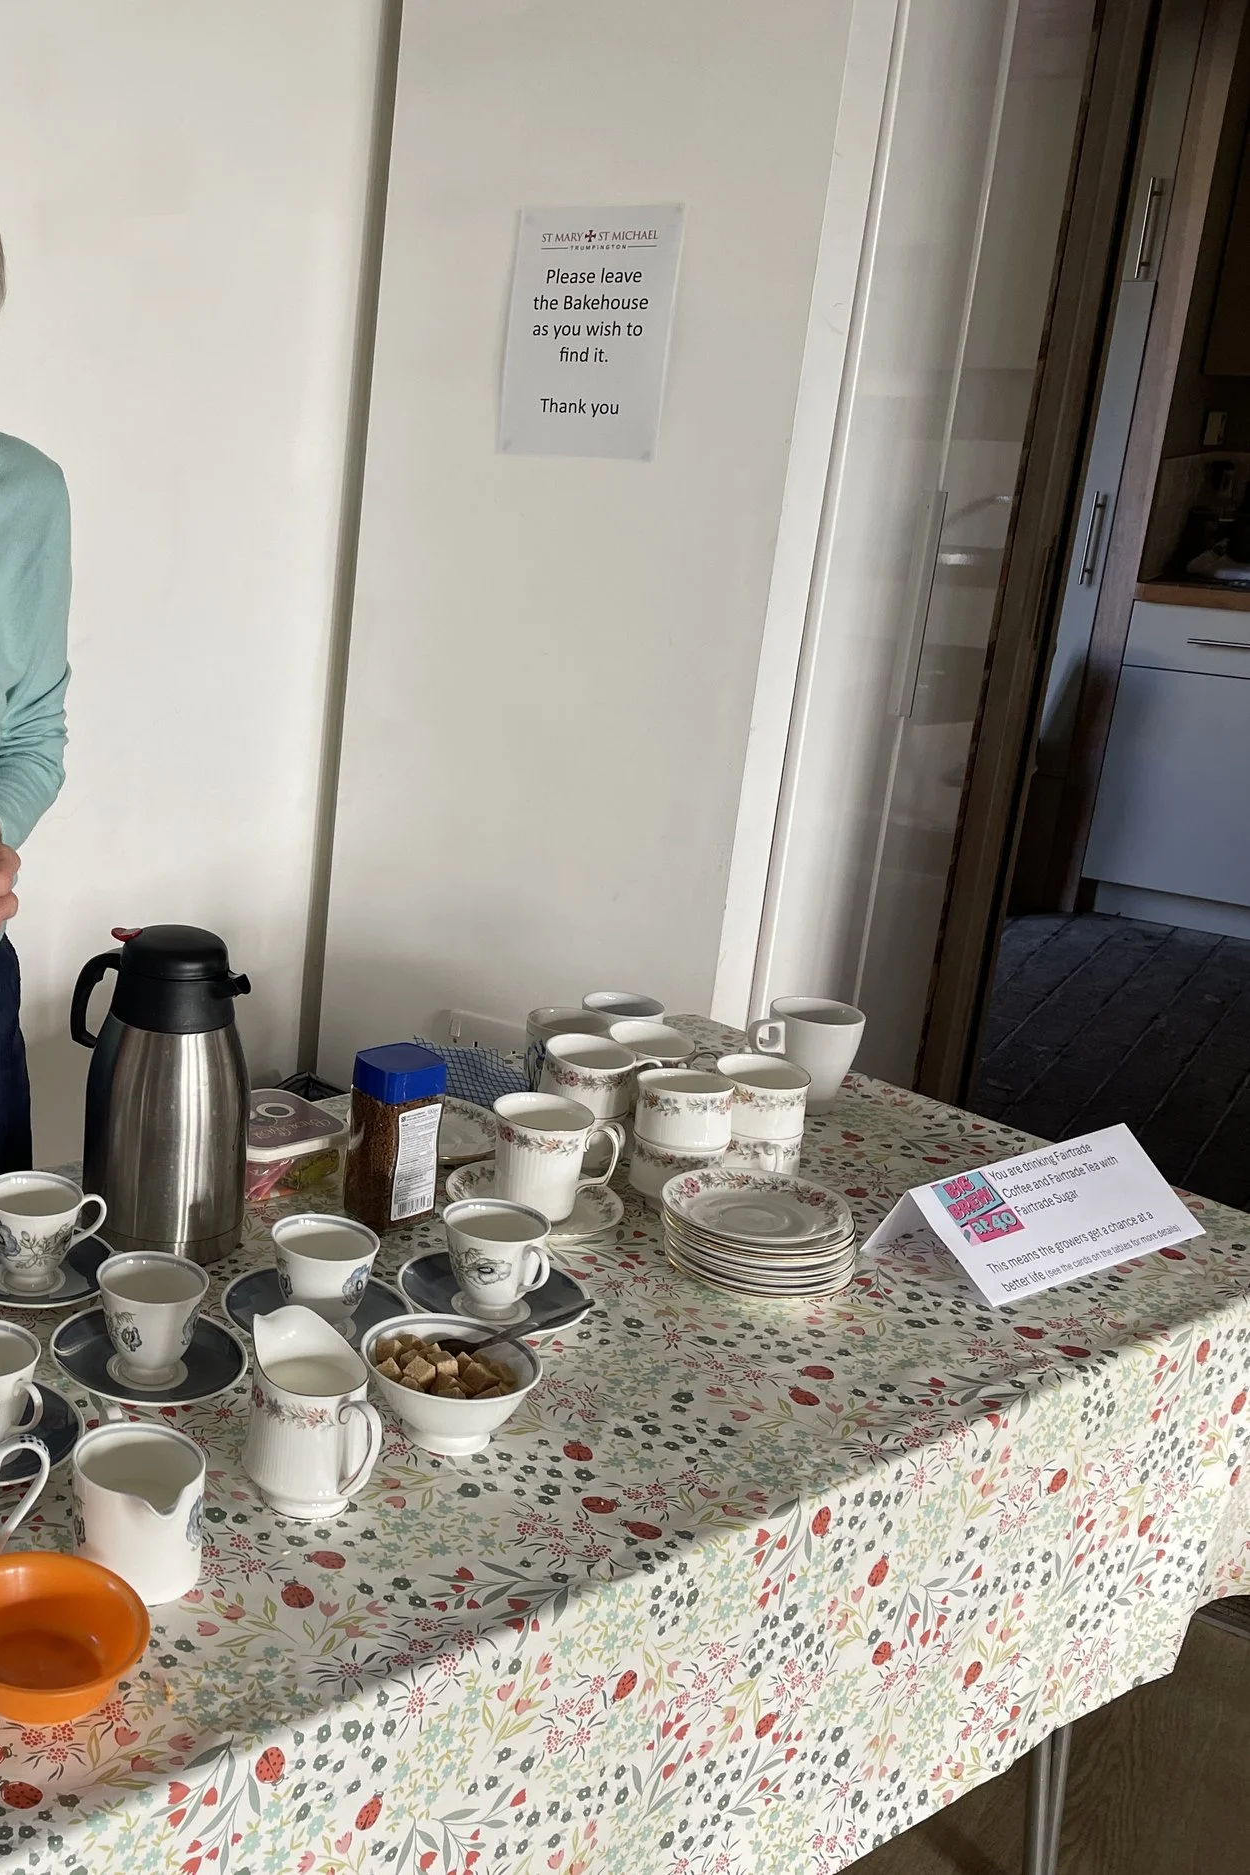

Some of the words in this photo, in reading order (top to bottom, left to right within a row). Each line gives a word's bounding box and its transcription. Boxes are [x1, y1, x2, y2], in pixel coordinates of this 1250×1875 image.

[542, 232, 554, 242] ST
[555, 232, 584, 242] MARY
[598, 232, 611, 241] ST
[612, 230, 658, 241] MICHAEL
[546, 269, 596, 284] Please
[600, 268, 642, 283] leave
[533, 295, 558, 310] the
[563, 295, 648, 310] Bakehouse
[532, 324, 548, 336] as
[553, 323, 580, 340] you
[586, 321, 621, 336] wish
[626, 322, 643, 336] to
[559, 347, 589, 362] find
[594, 348, 609, 362] it.
[540, 398, 586, 414] Thank
[590, 401, 620, 418] you
[988, 1170, 1008, 1182] You
[1008, 1166, 1022, 1176] are
[1022, 1154, 1058, 1172] drinking
[1054, 1142, 1092, 1162] Fairtrade
[943, 1176, 975, 1200] BIG
[1002, 1182, 1034, 1198] Coffee
[1034, 1177, 1050, 1190] and
[1048, 1166, 1086, 1184] Fairtrade
[1083, 1162, 1100, 1172] Tea
[1101, 1155, 1118, 1168] with
[947, 1186, 996, 1221] BREW
[1014, 1196, 1055, 1216] Fairtrade
[1053, 1189, 1078, 1204] Sugar
[971, 1218, 994, 1234] at
[992, 1212, 1017, 1232] 40
[986, 1258, 1009, 1275] This
[1008, 1249, 1041, 1266] means
[1038, 1242, 1056, 1257] the
[1054, 1232, 1090, 1254] growers
[1088, 1228, 1103, 1242] get
[1101, 1226, 1109, 1235] a
[1108, 1217, 1139, 1234] chance
[1138, 1212, 1148, 1223] at
[1146, 1211, 1154, 1220] a
[1001, 1274, 1030, 1292] better
[1028, 1268, 1046, 1285] life
[1044, 1264, 1062, 1279] (see
[1060, 1260, 1074, 1271] the
[1072, 1256, 1093, 1268] cards
[1092, 1252, 1102, 1261] on
[1100, 1247, 1112, 1258] the
[1111, 1240, 1133, 1254] tables
[1130, 1236, 1142, 1248] for
[1140, 1232, 1158, 1244] more
